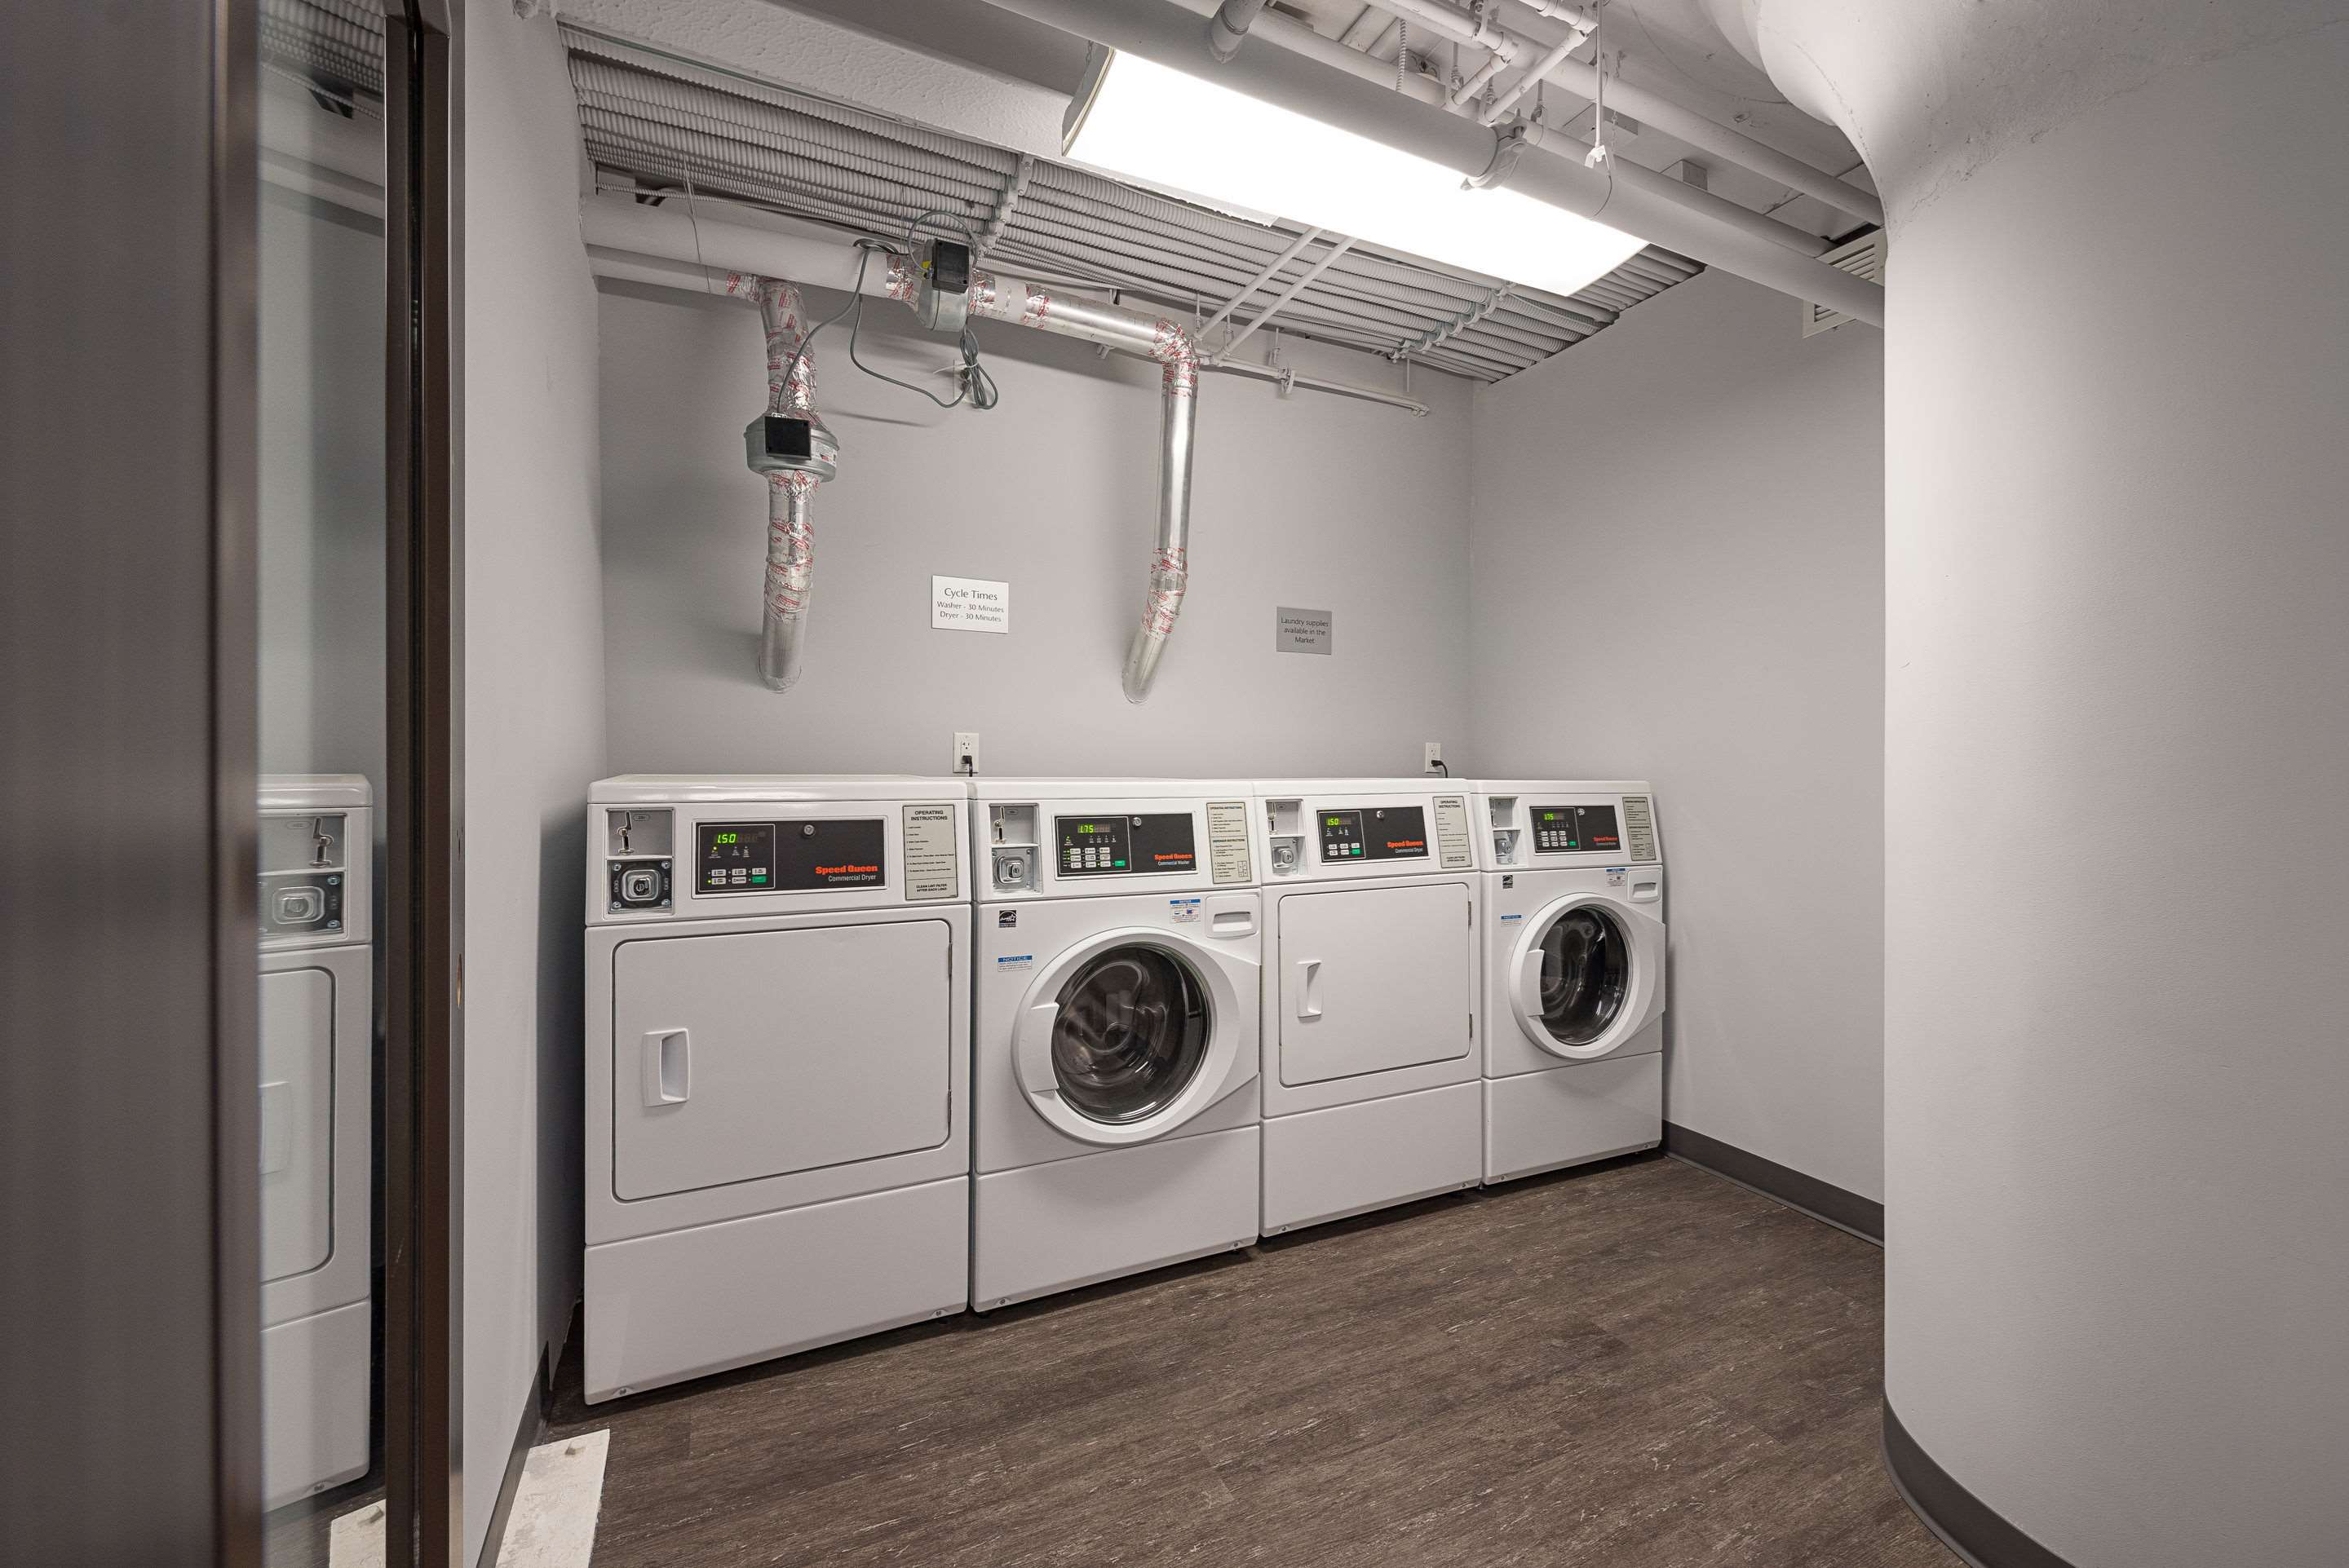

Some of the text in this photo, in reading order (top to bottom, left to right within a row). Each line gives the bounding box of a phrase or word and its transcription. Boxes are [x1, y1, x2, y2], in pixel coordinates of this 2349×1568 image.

[944, 587, 998, 601] Cycle Times
[936, 601, 962, 609] Washer
[940, 611, 958, 620] Dryer
[975, 614, 1002, 622] Minutes
[1281, 617, 1329, 628] Laundry supplies
[815, 864, 878, 875] Speed Queen
